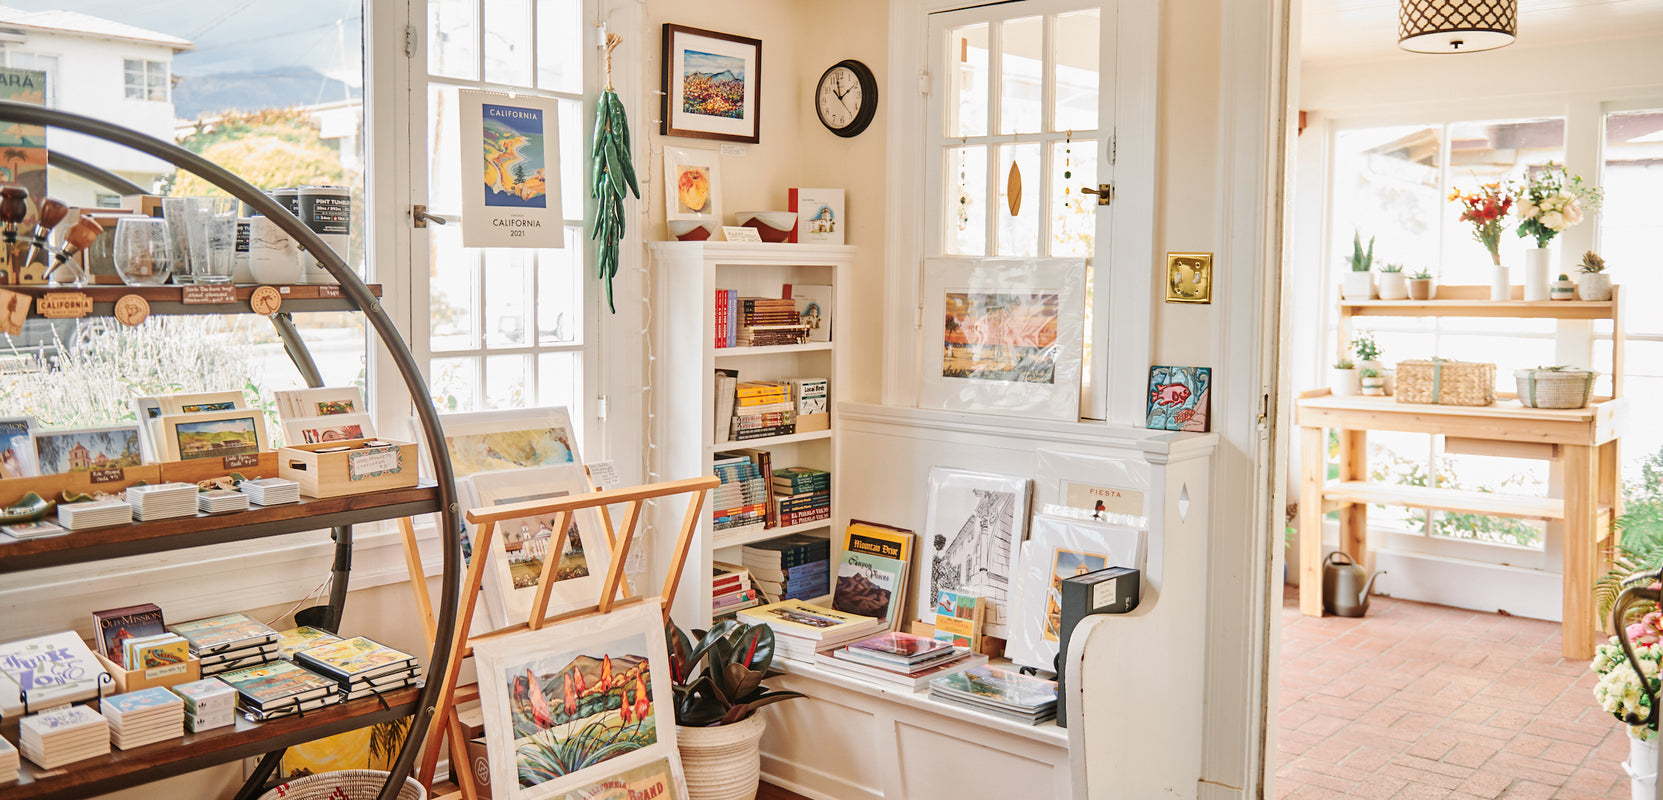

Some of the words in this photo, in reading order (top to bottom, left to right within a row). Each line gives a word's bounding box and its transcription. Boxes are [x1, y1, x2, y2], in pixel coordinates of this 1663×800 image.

[489, 109, 538, 120] CALIFORNIA
[492, 218, 541, 227] CALIFORNIA
[510, 229, 525, 237] 2021
[41, 301, 89, 309] CALIFORNIA
[1089, 488, 1121, 498] FIESTA
[853, 539, 881, 552] Mountain
[882, 544, 898, 556] Drive
[848, 555, 872, 569] Canyon
[121, 611, 162, 625] MISSION
[628, 781, 664, 800] BRAND
